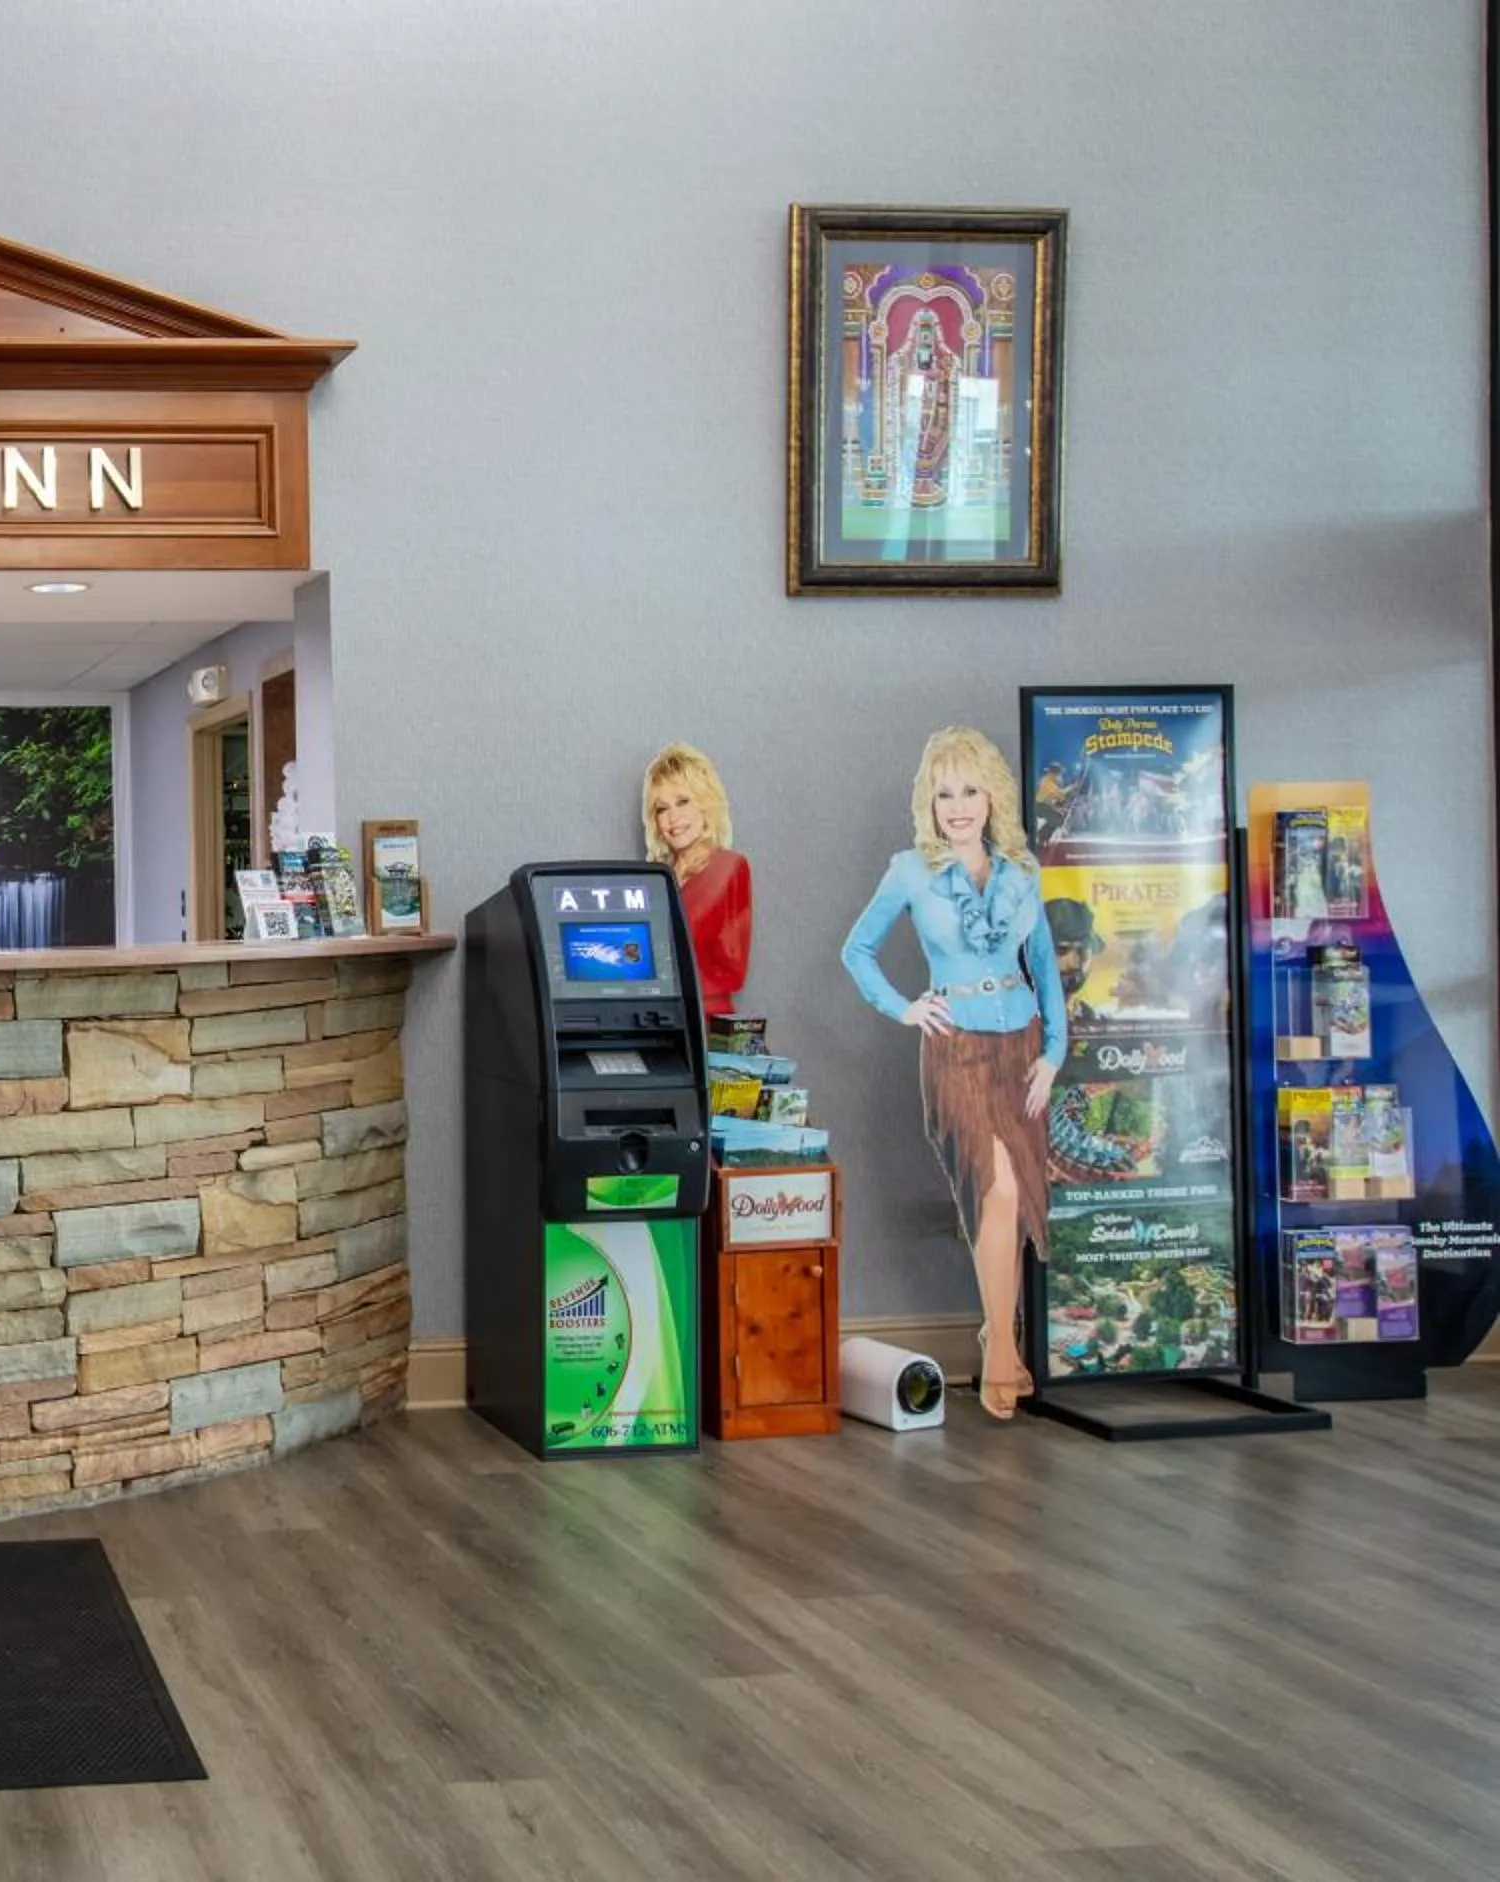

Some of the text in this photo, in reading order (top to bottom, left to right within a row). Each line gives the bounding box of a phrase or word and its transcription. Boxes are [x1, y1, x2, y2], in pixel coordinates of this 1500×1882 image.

[1085, 731, 1173, 755] Stampede
[559, 888, 645, 910] ATM
[1092, 882, 1181, 905] PIRATES
[1422, 1247, 1492, 1260] Destination
[549, 1317, 605, 1329] BOOSTERS
